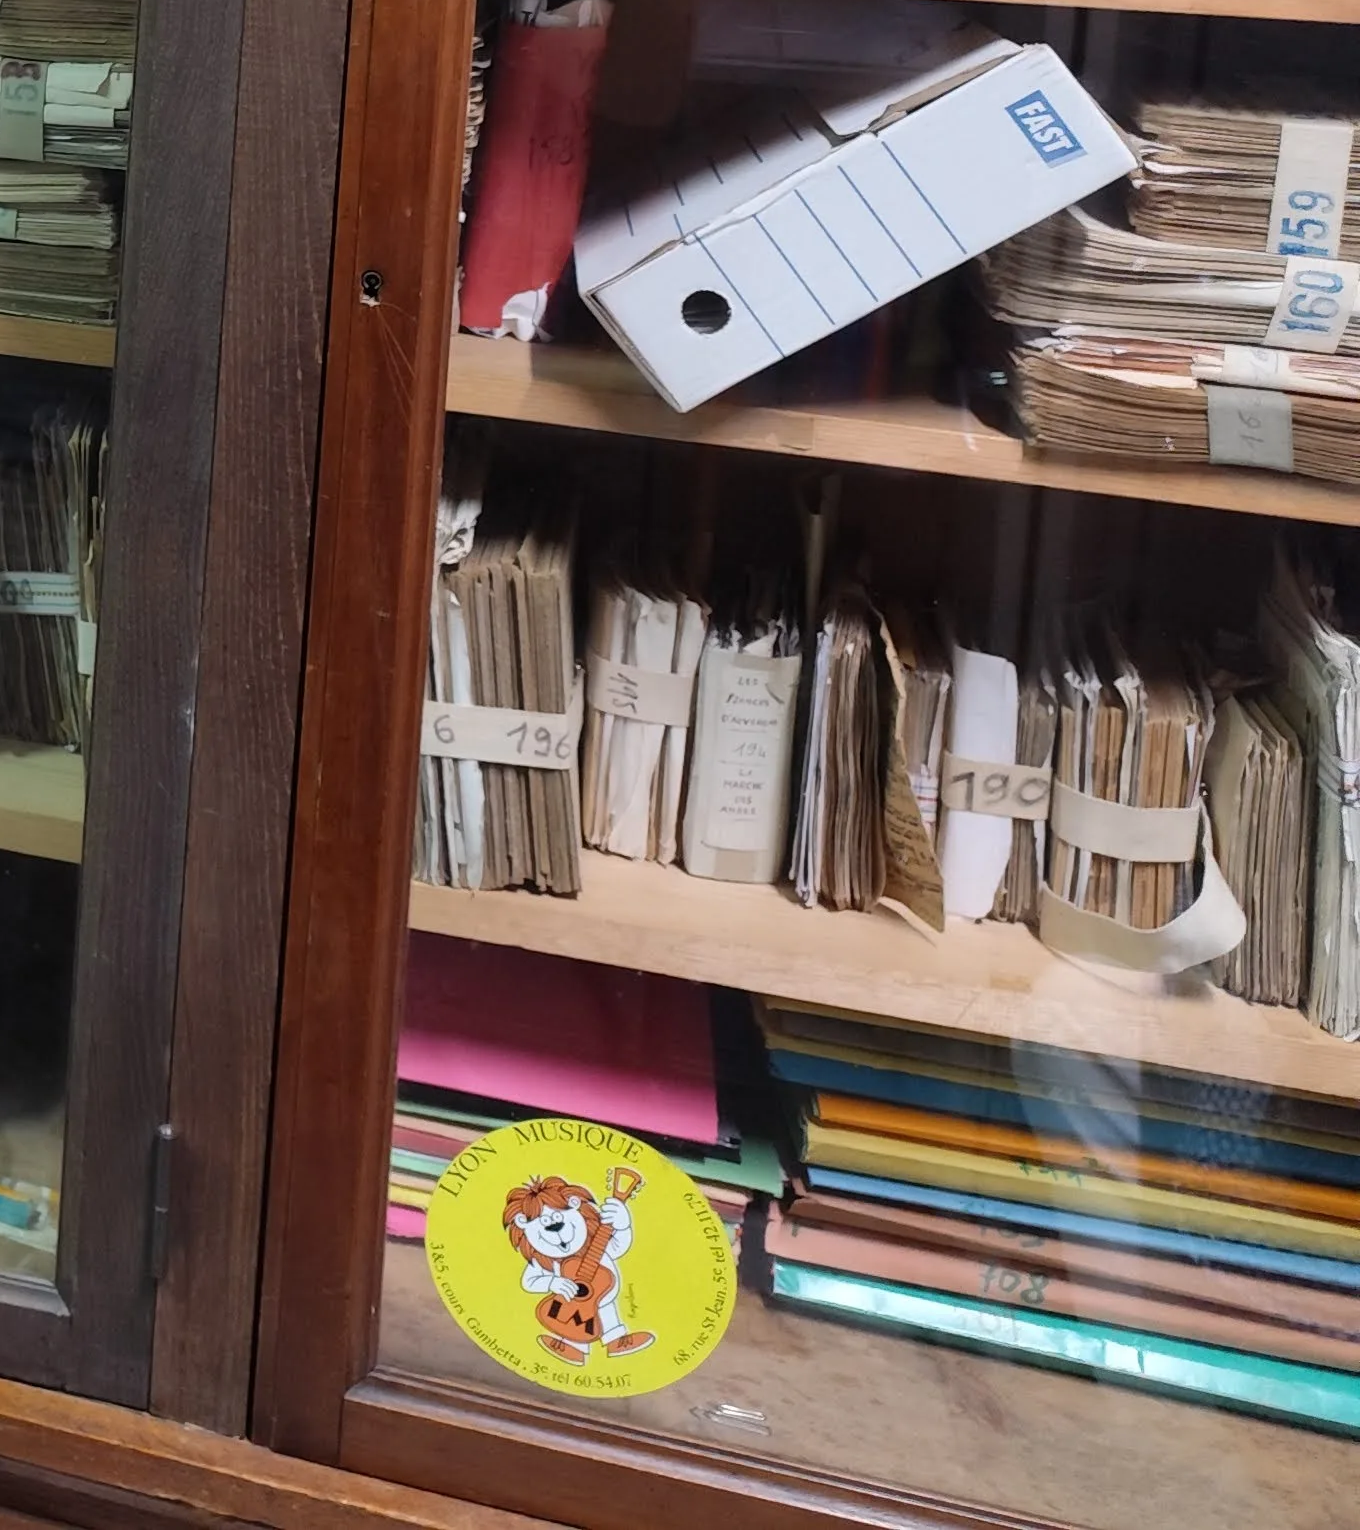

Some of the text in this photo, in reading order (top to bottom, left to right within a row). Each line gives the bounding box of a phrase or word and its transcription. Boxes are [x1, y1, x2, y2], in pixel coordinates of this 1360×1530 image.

[1014, 100, 1075, 152] FAST
[1277, 189, 1335, 256] 159
[1278, 269, 1344, 333] 160
[506, 721, 572, 760] 196
[951, 771, 1049, 810] 190
[438, 1121, 644, 1198] LYON MUSIQUE
